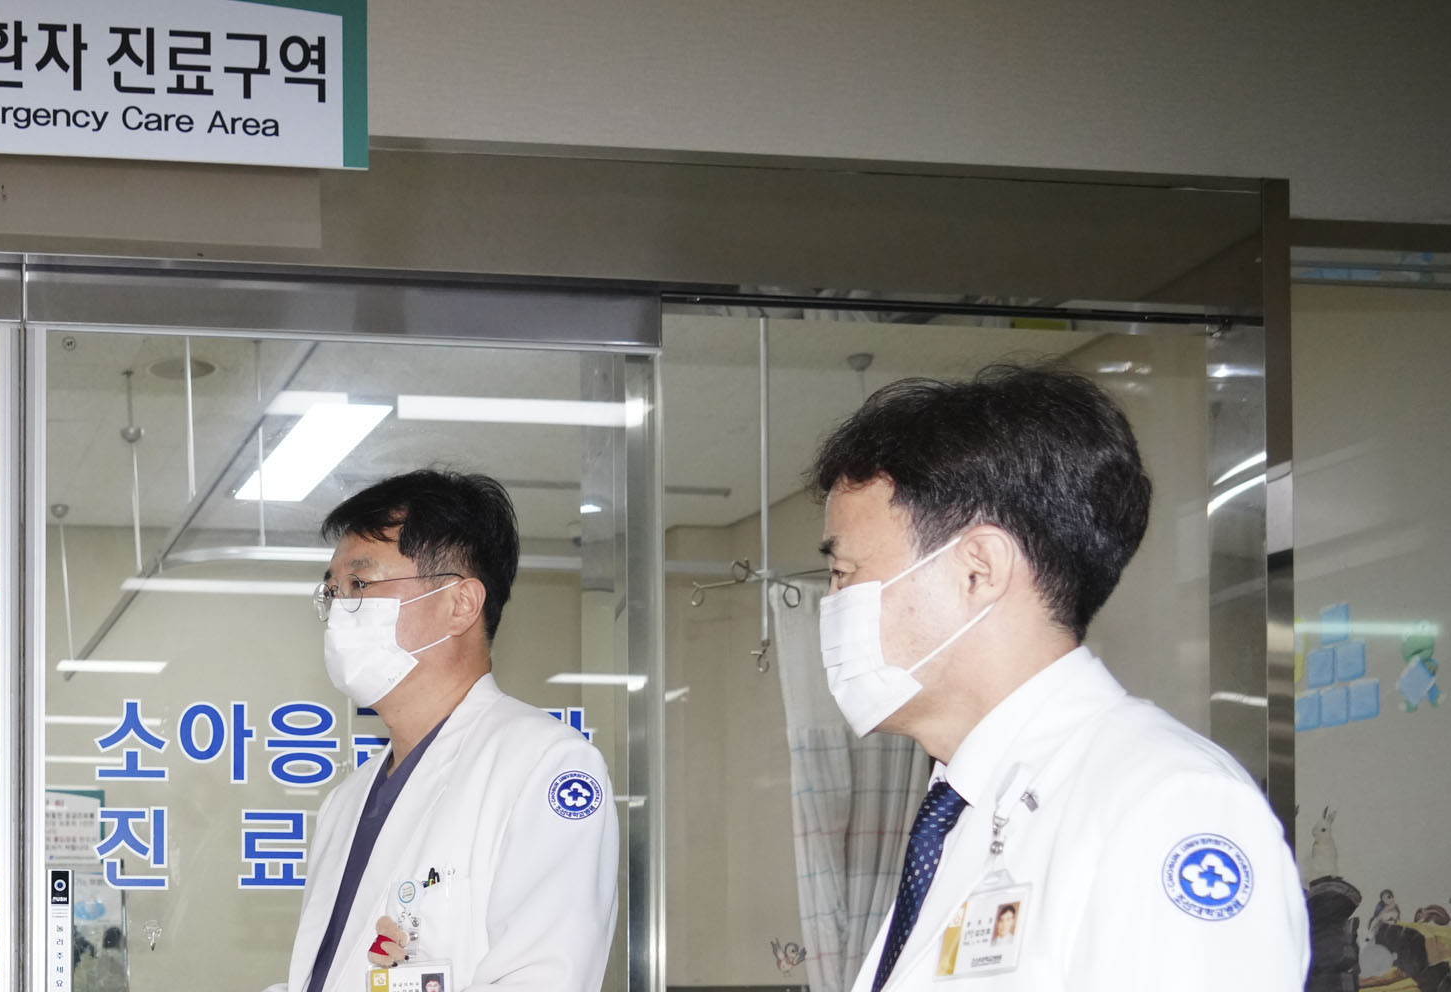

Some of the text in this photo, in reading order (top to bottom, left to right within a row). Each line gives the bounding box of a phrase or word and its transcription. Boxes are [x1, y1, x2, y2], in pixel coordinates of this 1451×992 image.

[106, 26, 327, 104] 진료구역
[121, 105, 195, 133] Care
[206, 109, 280, 137] Area
